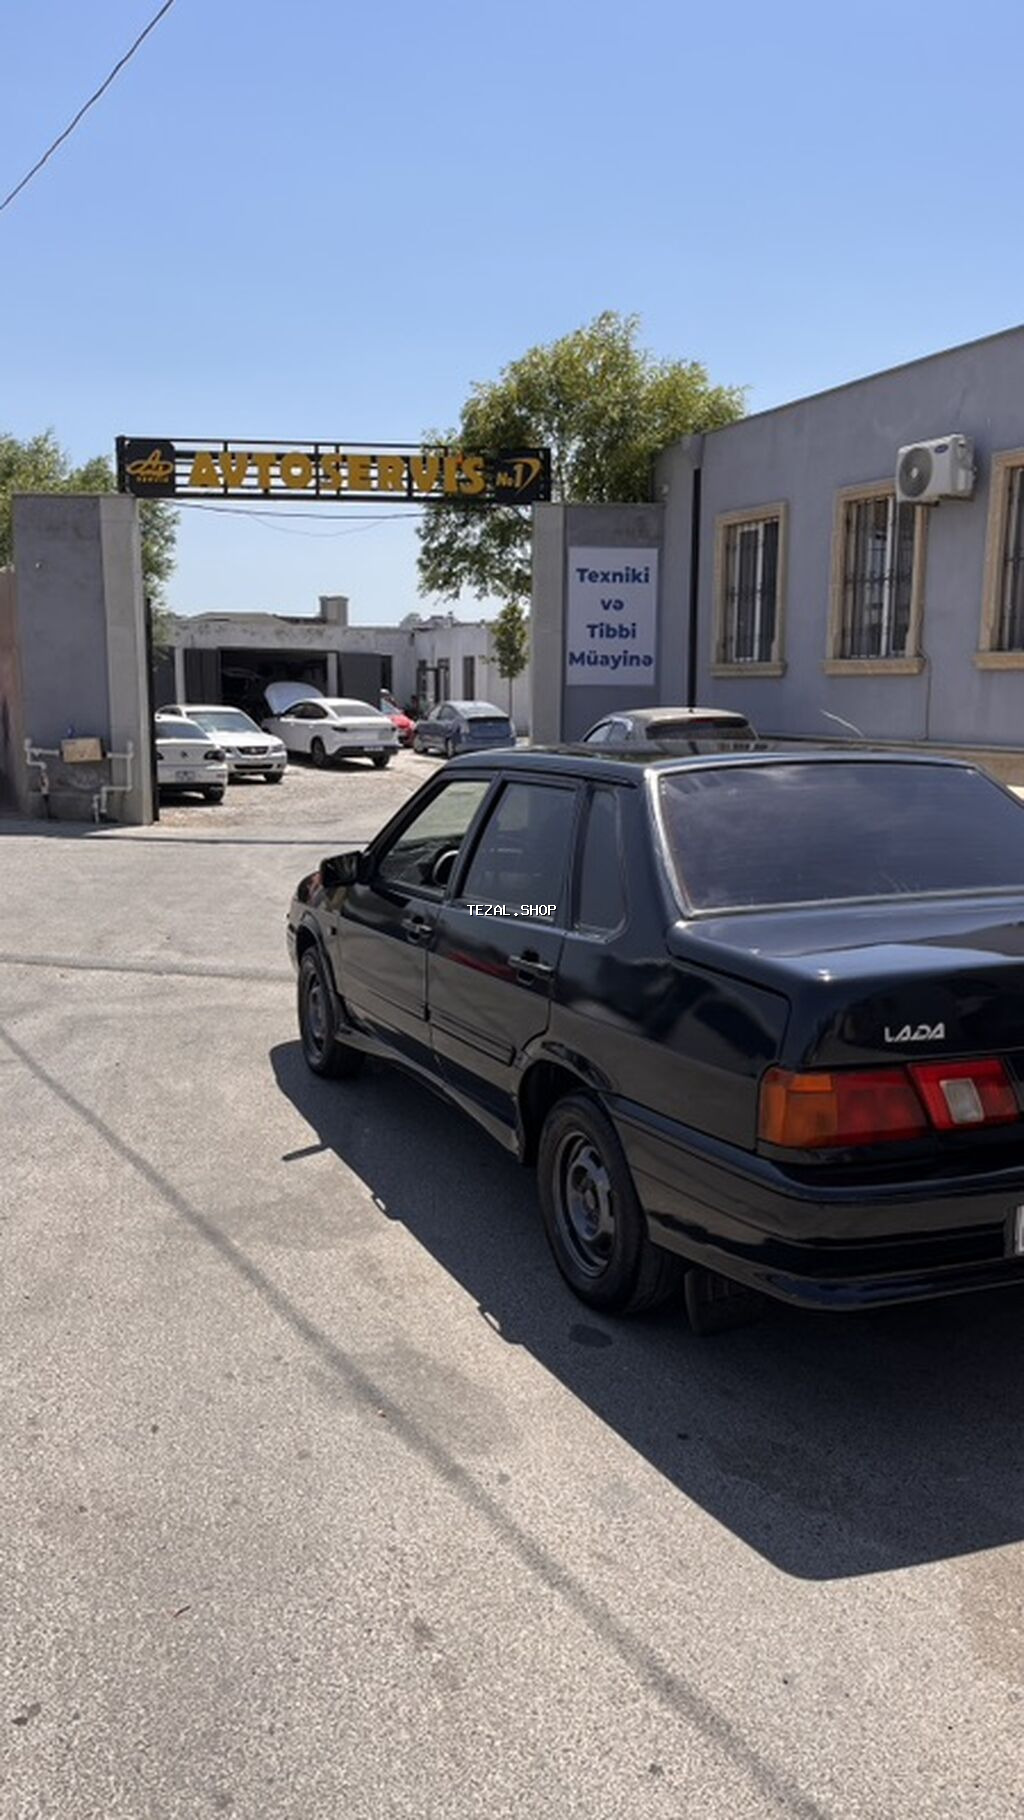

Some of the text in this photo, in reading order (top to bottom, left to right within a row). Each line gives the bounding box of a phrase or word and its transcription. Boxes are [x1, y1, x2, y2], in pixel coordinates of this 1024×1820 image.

[188, 451, 487, 494] AVTOSERVIS
[576, 566, 649, 583] Texniki
[601, 599, 624, 611] və
[586, 622, 637, 639] Tibbi
[568, 650, 654, 670] Müayinə
[884, 1022, 945, 1042] LADA
